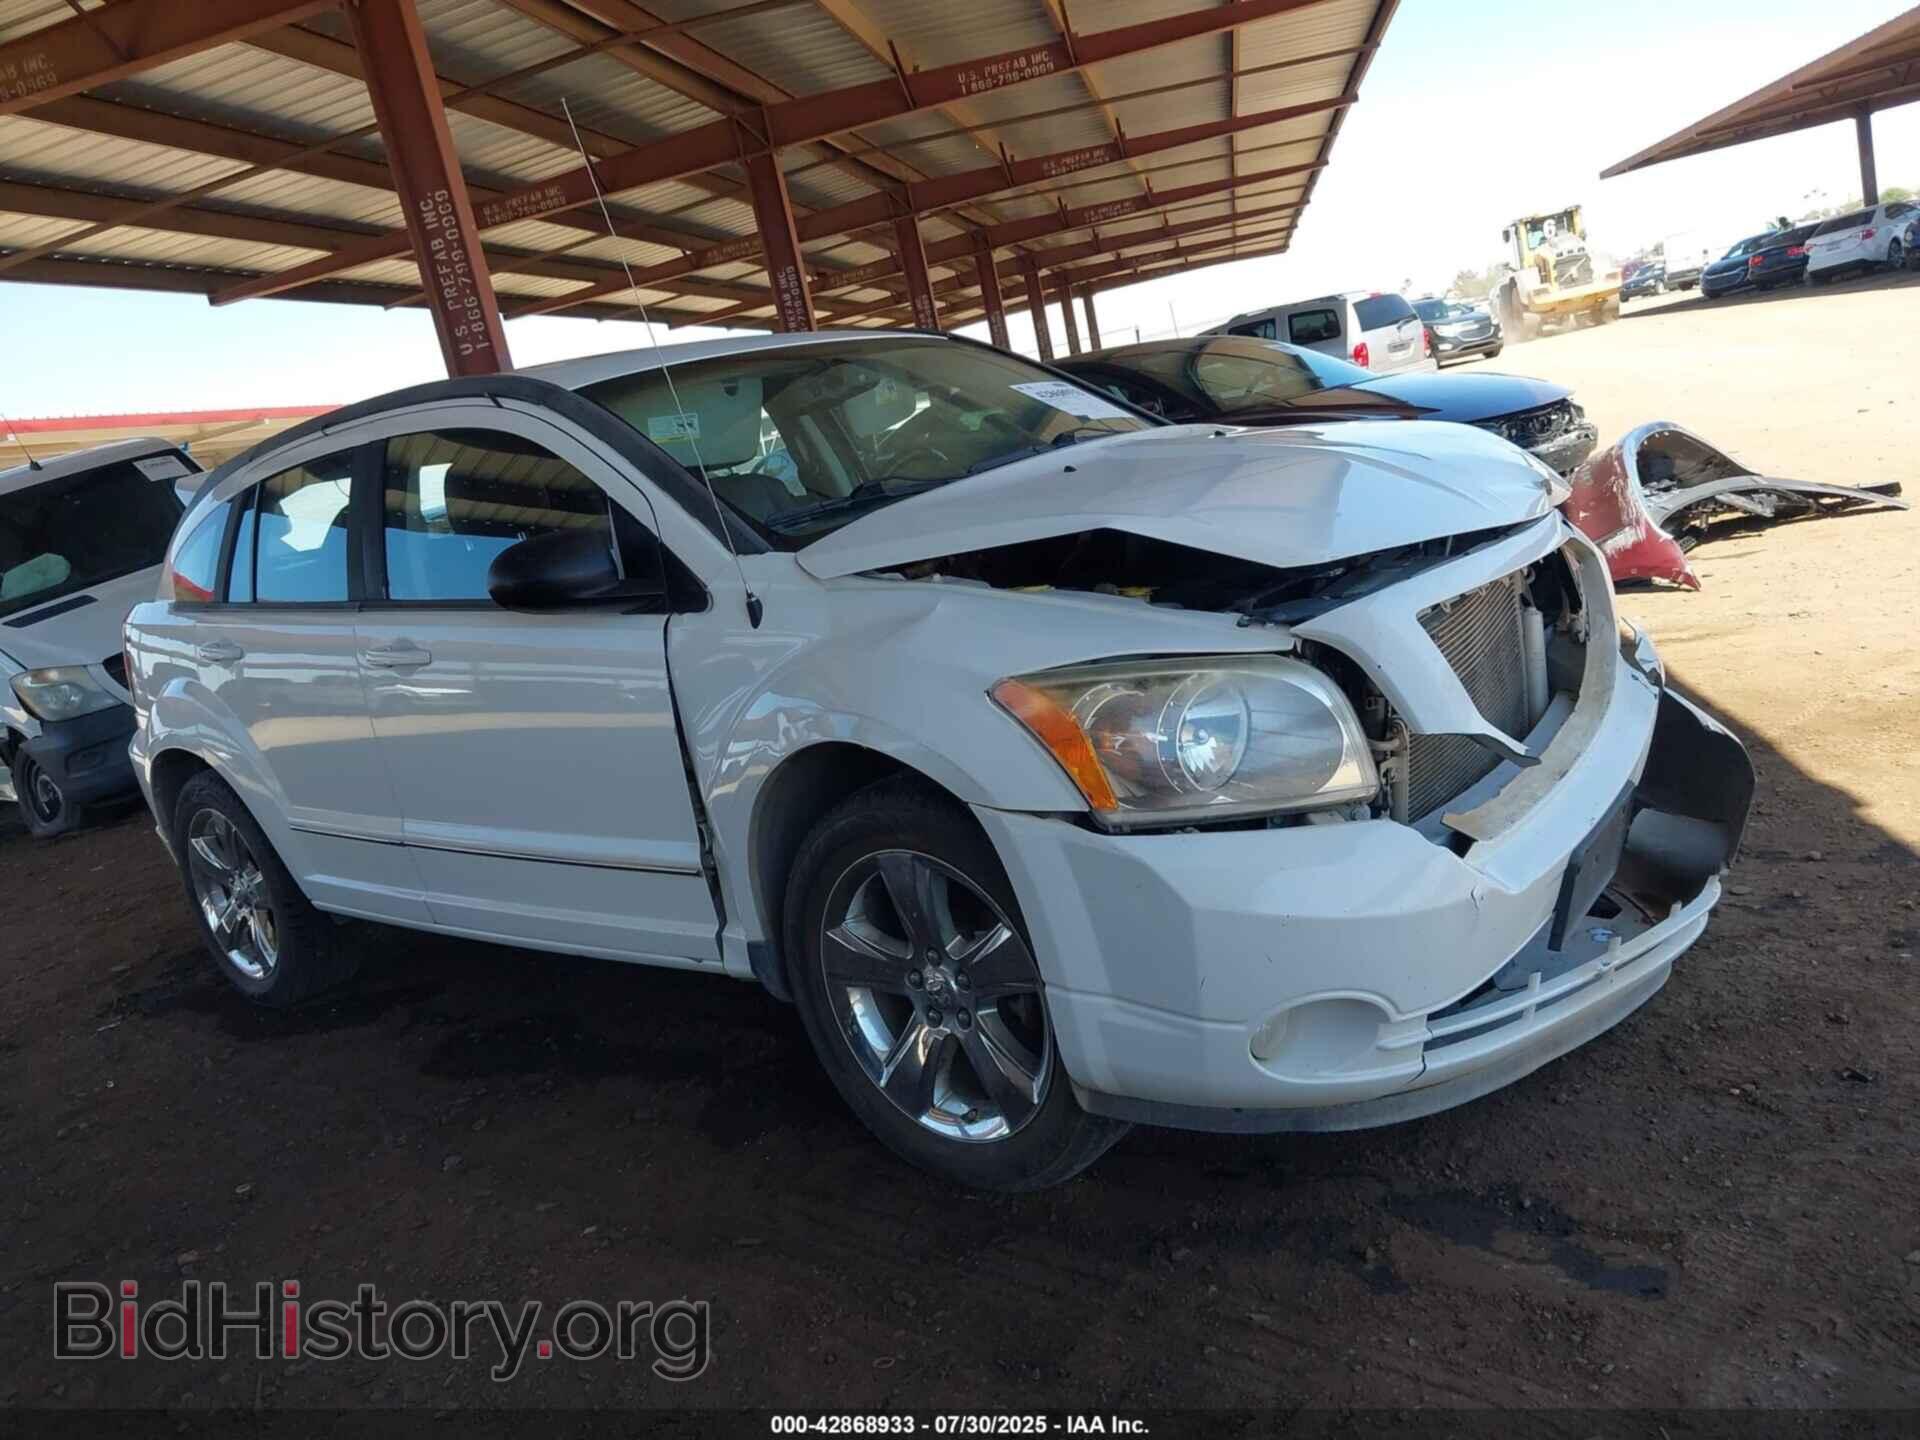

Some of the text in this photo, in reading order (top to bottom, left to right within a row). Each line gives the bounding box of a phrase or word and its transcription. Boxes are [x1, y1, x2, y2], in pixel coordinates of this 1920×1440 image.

[984, 56, 1027, 78] PREFAB
[419, 192, 473, 356] U.S. PREFAB INC.
